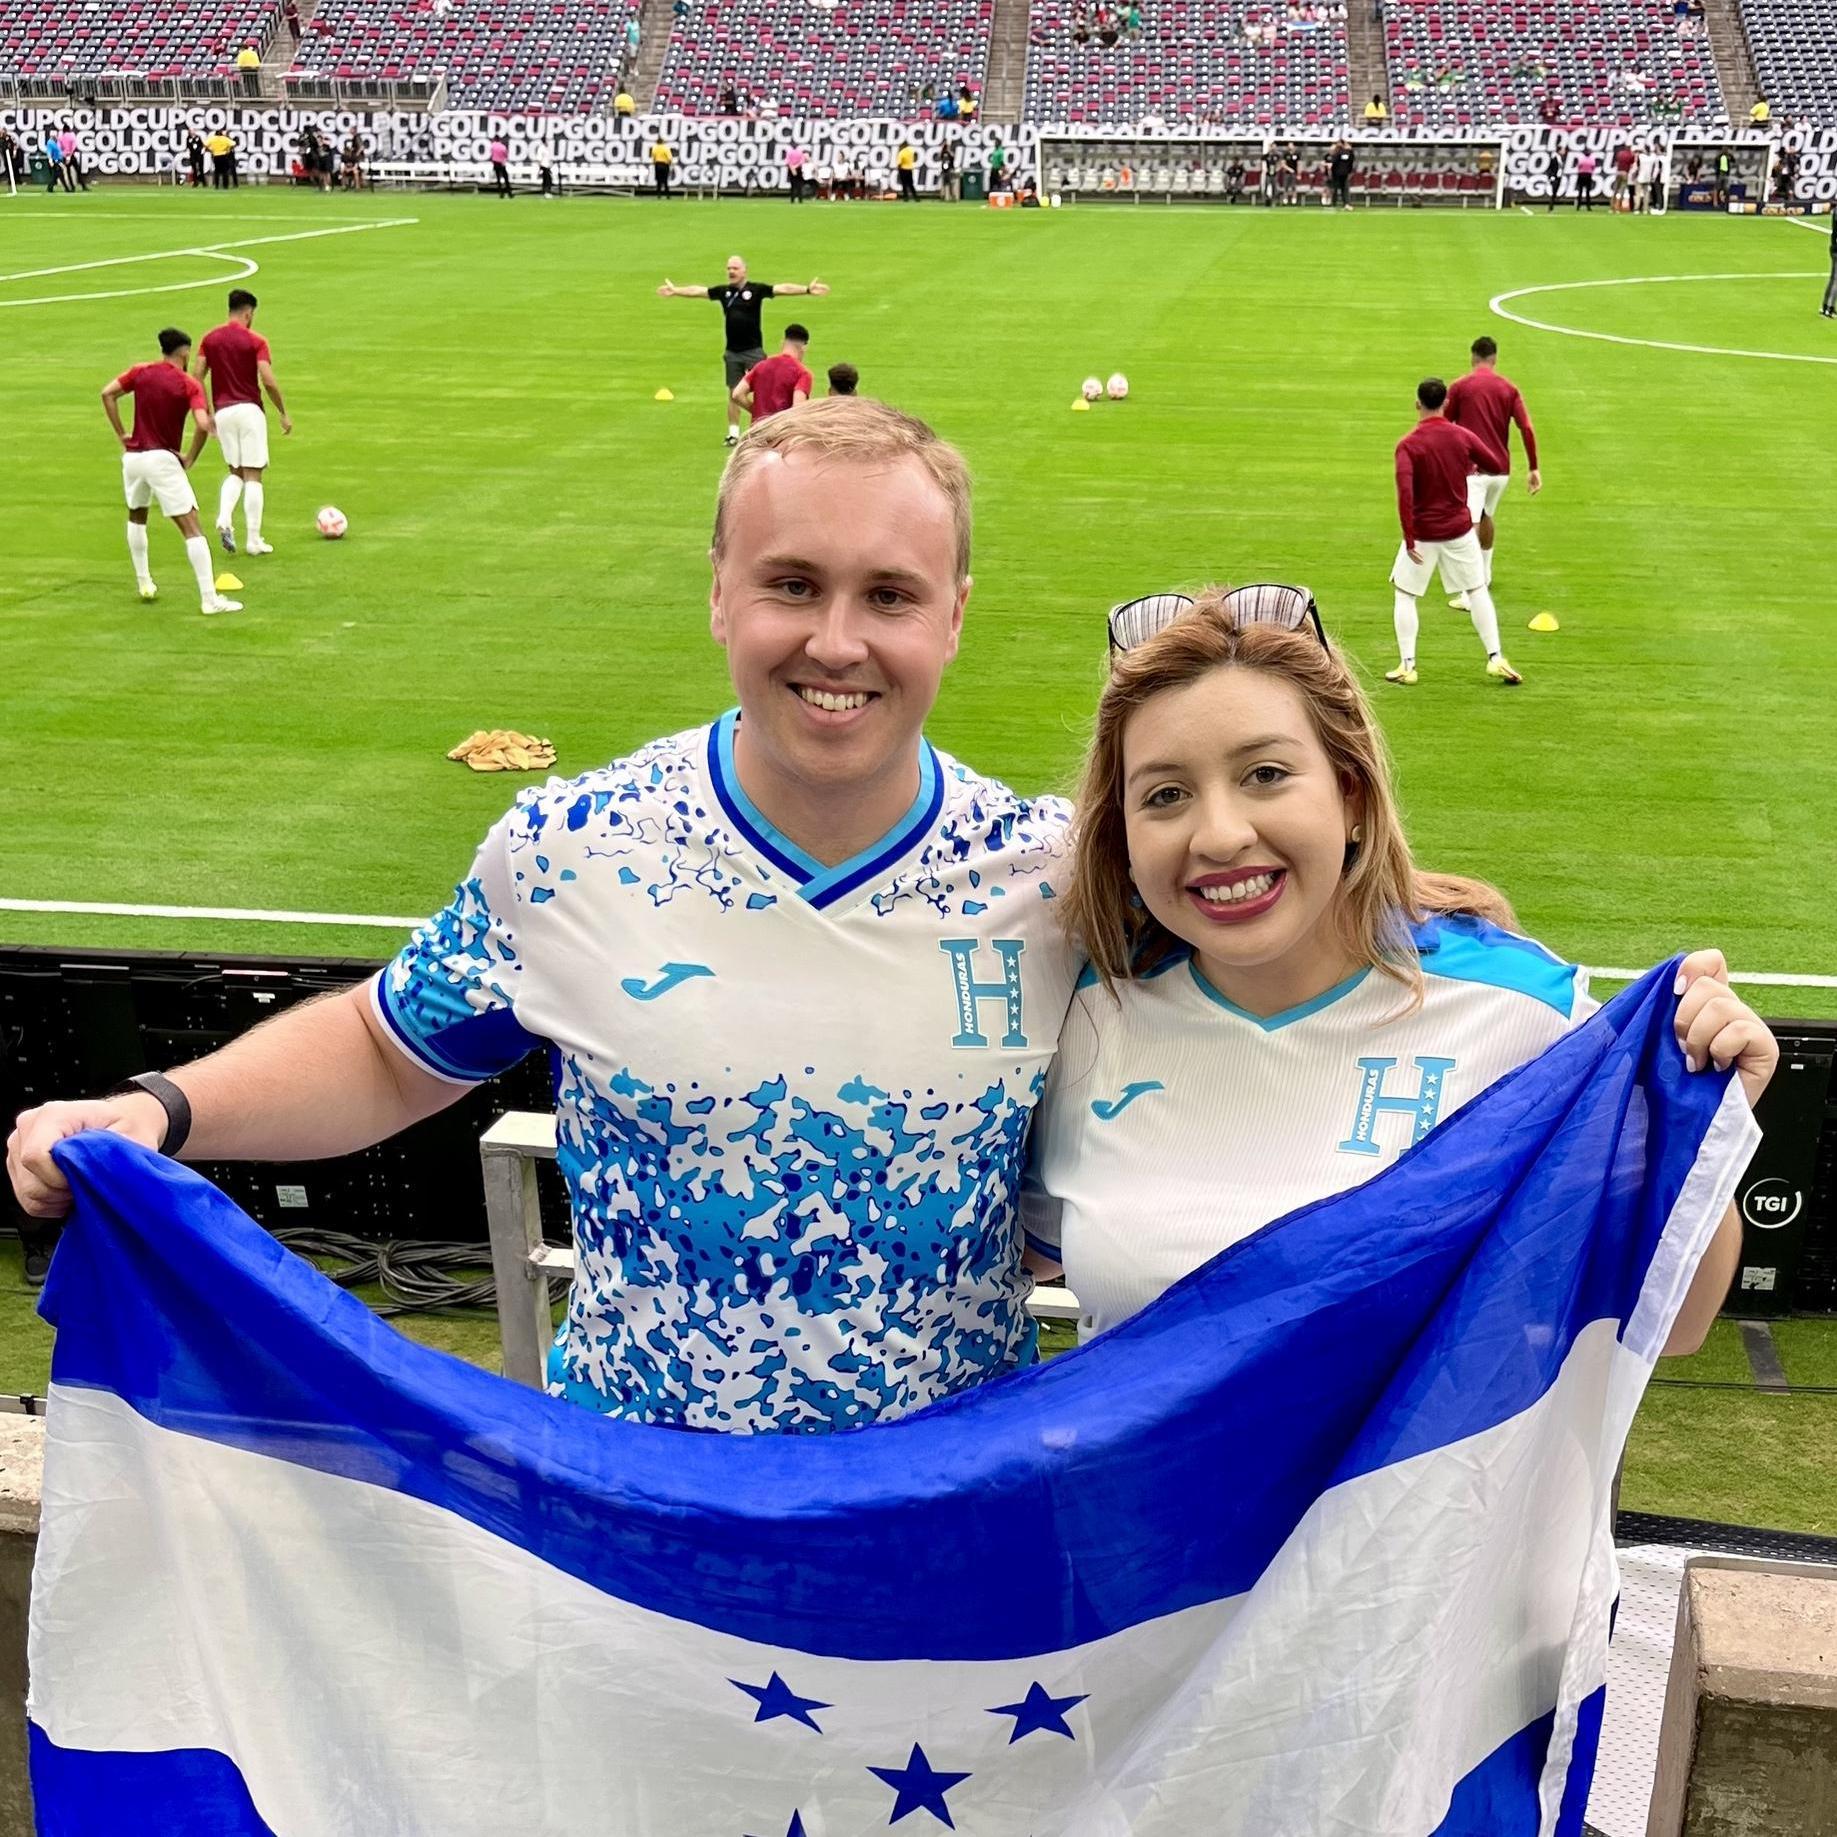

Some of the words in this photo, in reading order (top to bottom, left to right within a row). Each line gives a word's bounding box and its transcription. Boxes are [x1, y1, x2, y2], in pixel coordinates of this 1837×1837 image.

[955, 952, 974, 1034] HONDURAS
[1355, 1069, 1379, 1142] HONDURAS
[1753, 1195, 1787, 1212] TGI
